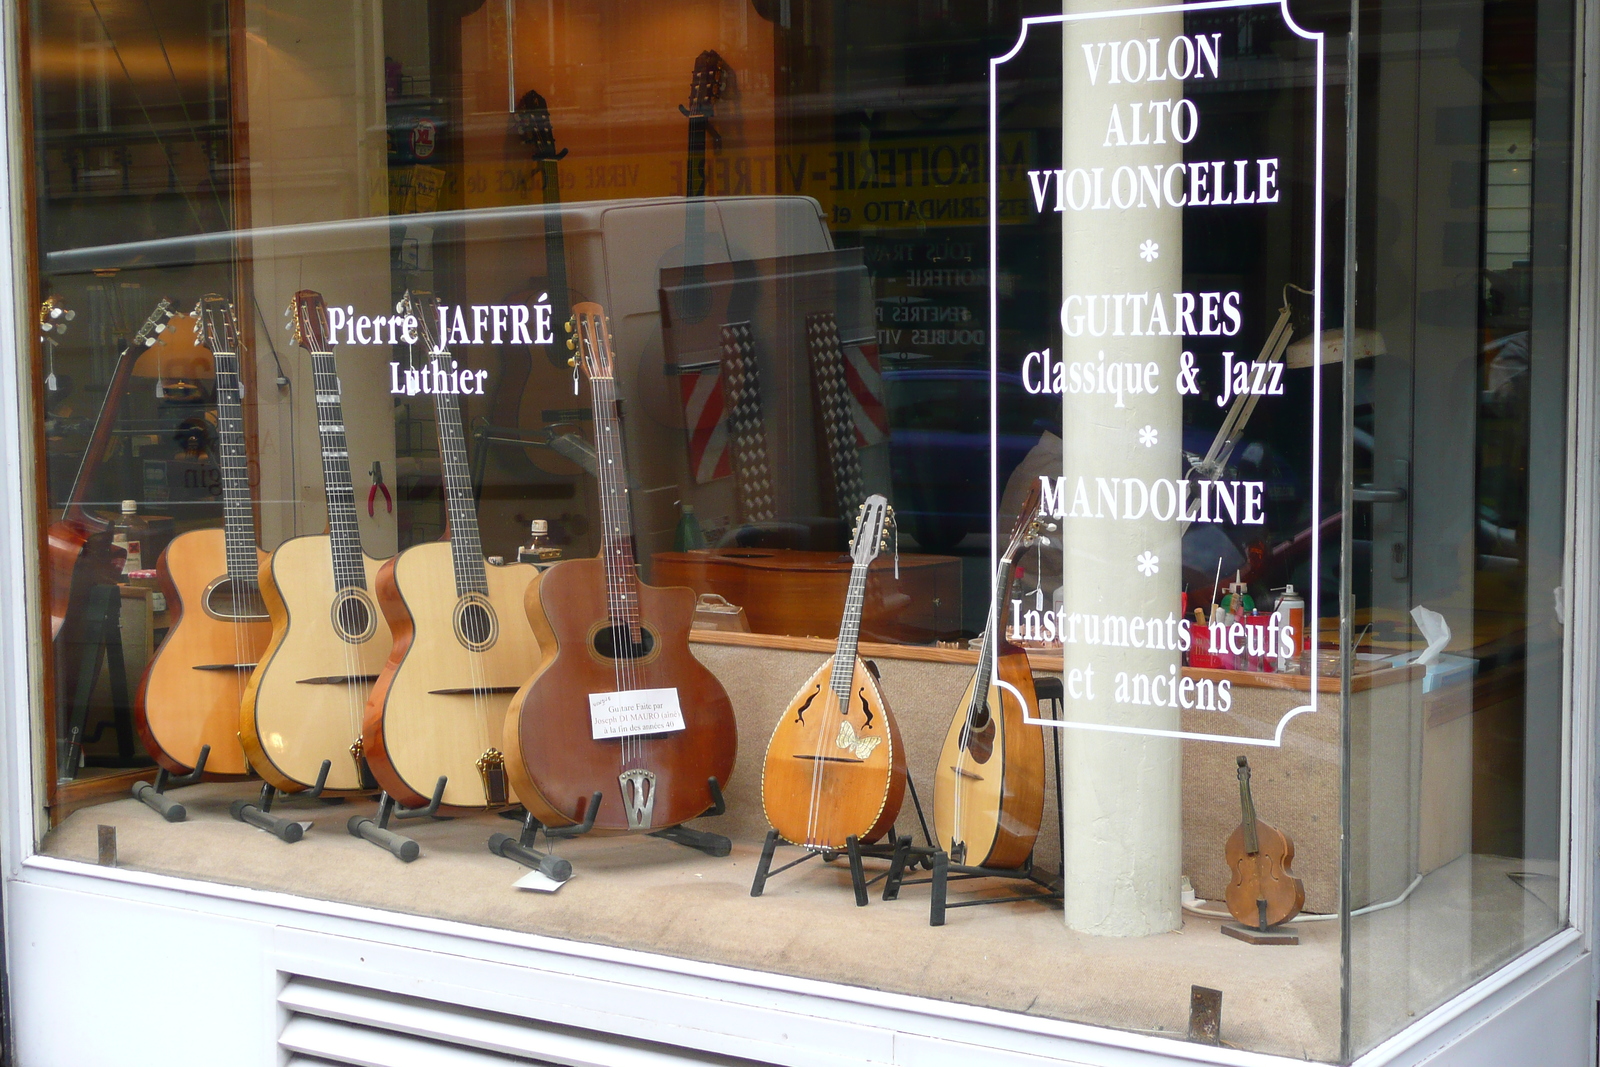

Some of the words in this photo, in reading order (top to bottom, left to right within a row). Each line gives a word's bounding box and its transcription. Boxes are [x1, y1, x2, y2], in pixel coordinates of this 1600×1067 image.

[1081, 33, 1222, 86] VIOLON
[1102, 98, 1199, 147] ALTO
[1027, 157, 1279, 213] VIOLONCELLE
[327, 306, 418, 345] Pierre
[434, 292, 554, 355] JAFFRÉ
[1060, 291, 1242, 337] GUITARES
[390, 359, 488, 395] Luthier
[1022, 348, 1160, 408] Classique
[1176, 351, 1200, 395] &
[1217, 351, 1284, 407] Jazz
[1038, 475, 1266, 525] MANDOLINE
[1010, 599, 1192, 652] Instruments
[1208, 611, 1295, 659] neufs
[1068, 662, 1095, 701] et
[1114, 663, 1232, 712] anciens
[594, 716, 617, 725] Joseph
[630, 712, 660, 721] MAURO
